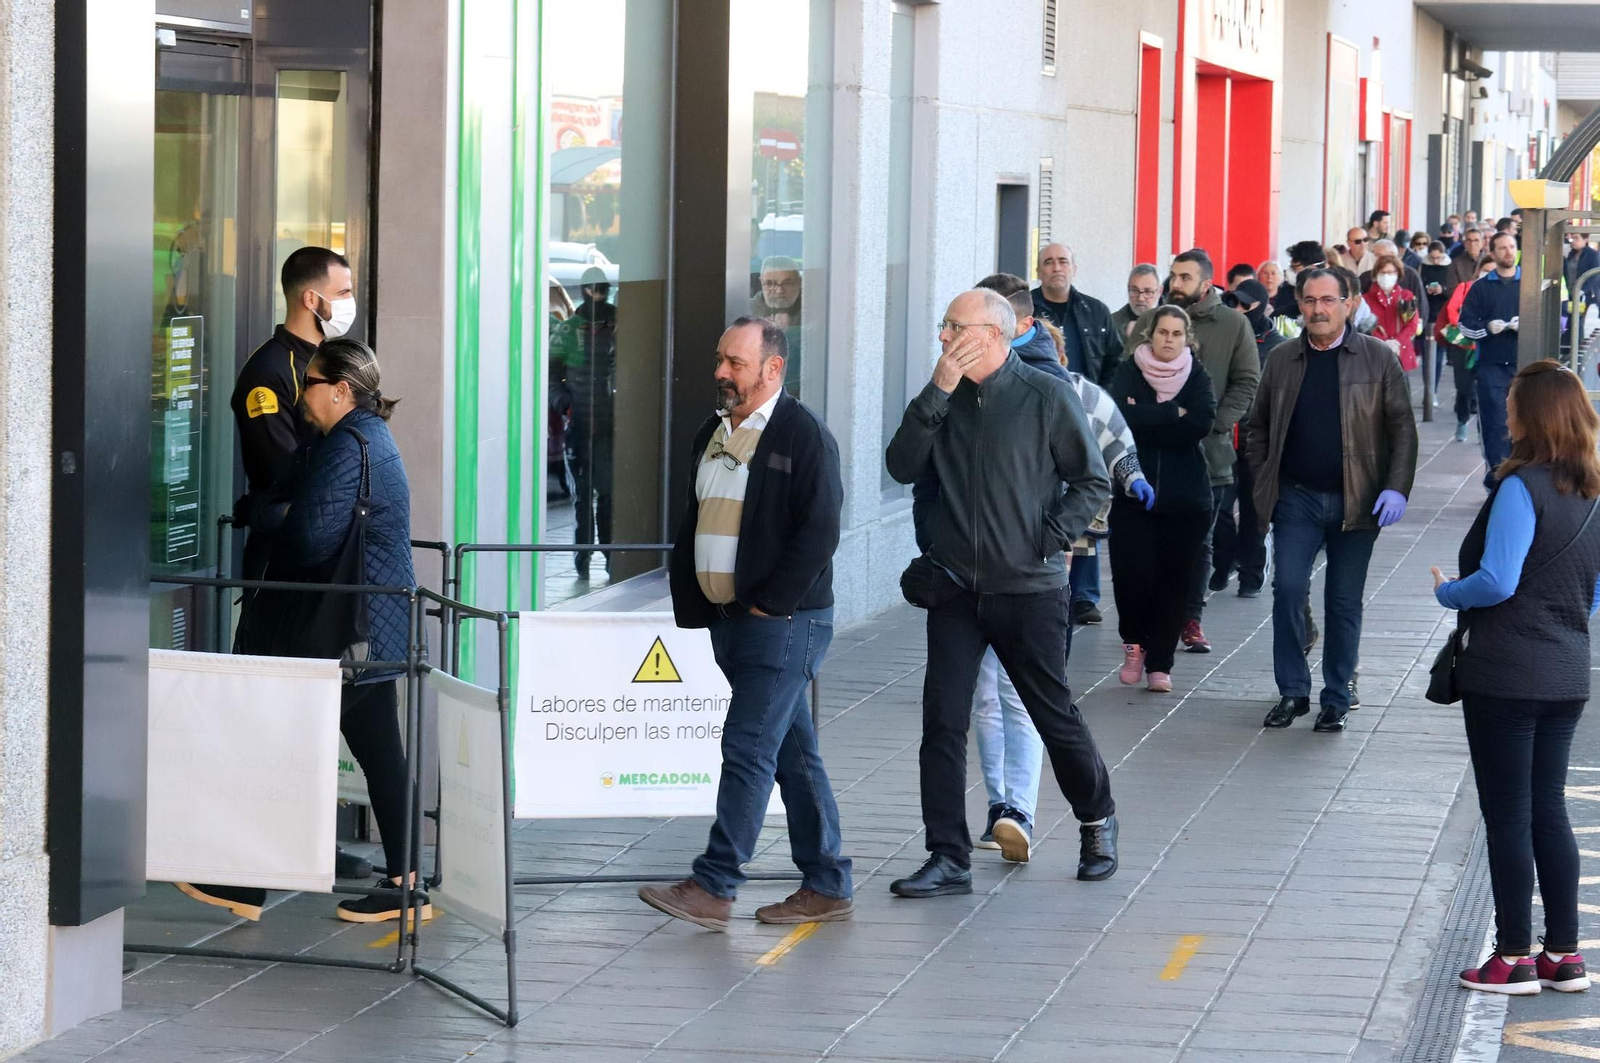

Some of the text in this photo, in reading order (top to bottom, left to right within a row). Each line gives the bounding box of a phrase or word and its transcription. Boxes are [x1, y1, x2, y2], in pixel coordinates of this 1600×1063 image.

[530, 695, 606, 713] Labores
[613, 694, 637, 712] de
[545, 722, 638, 744] Disculpen
[644, 722, 670, 740] las
[618, 772, 712, 785] MERCADONA
